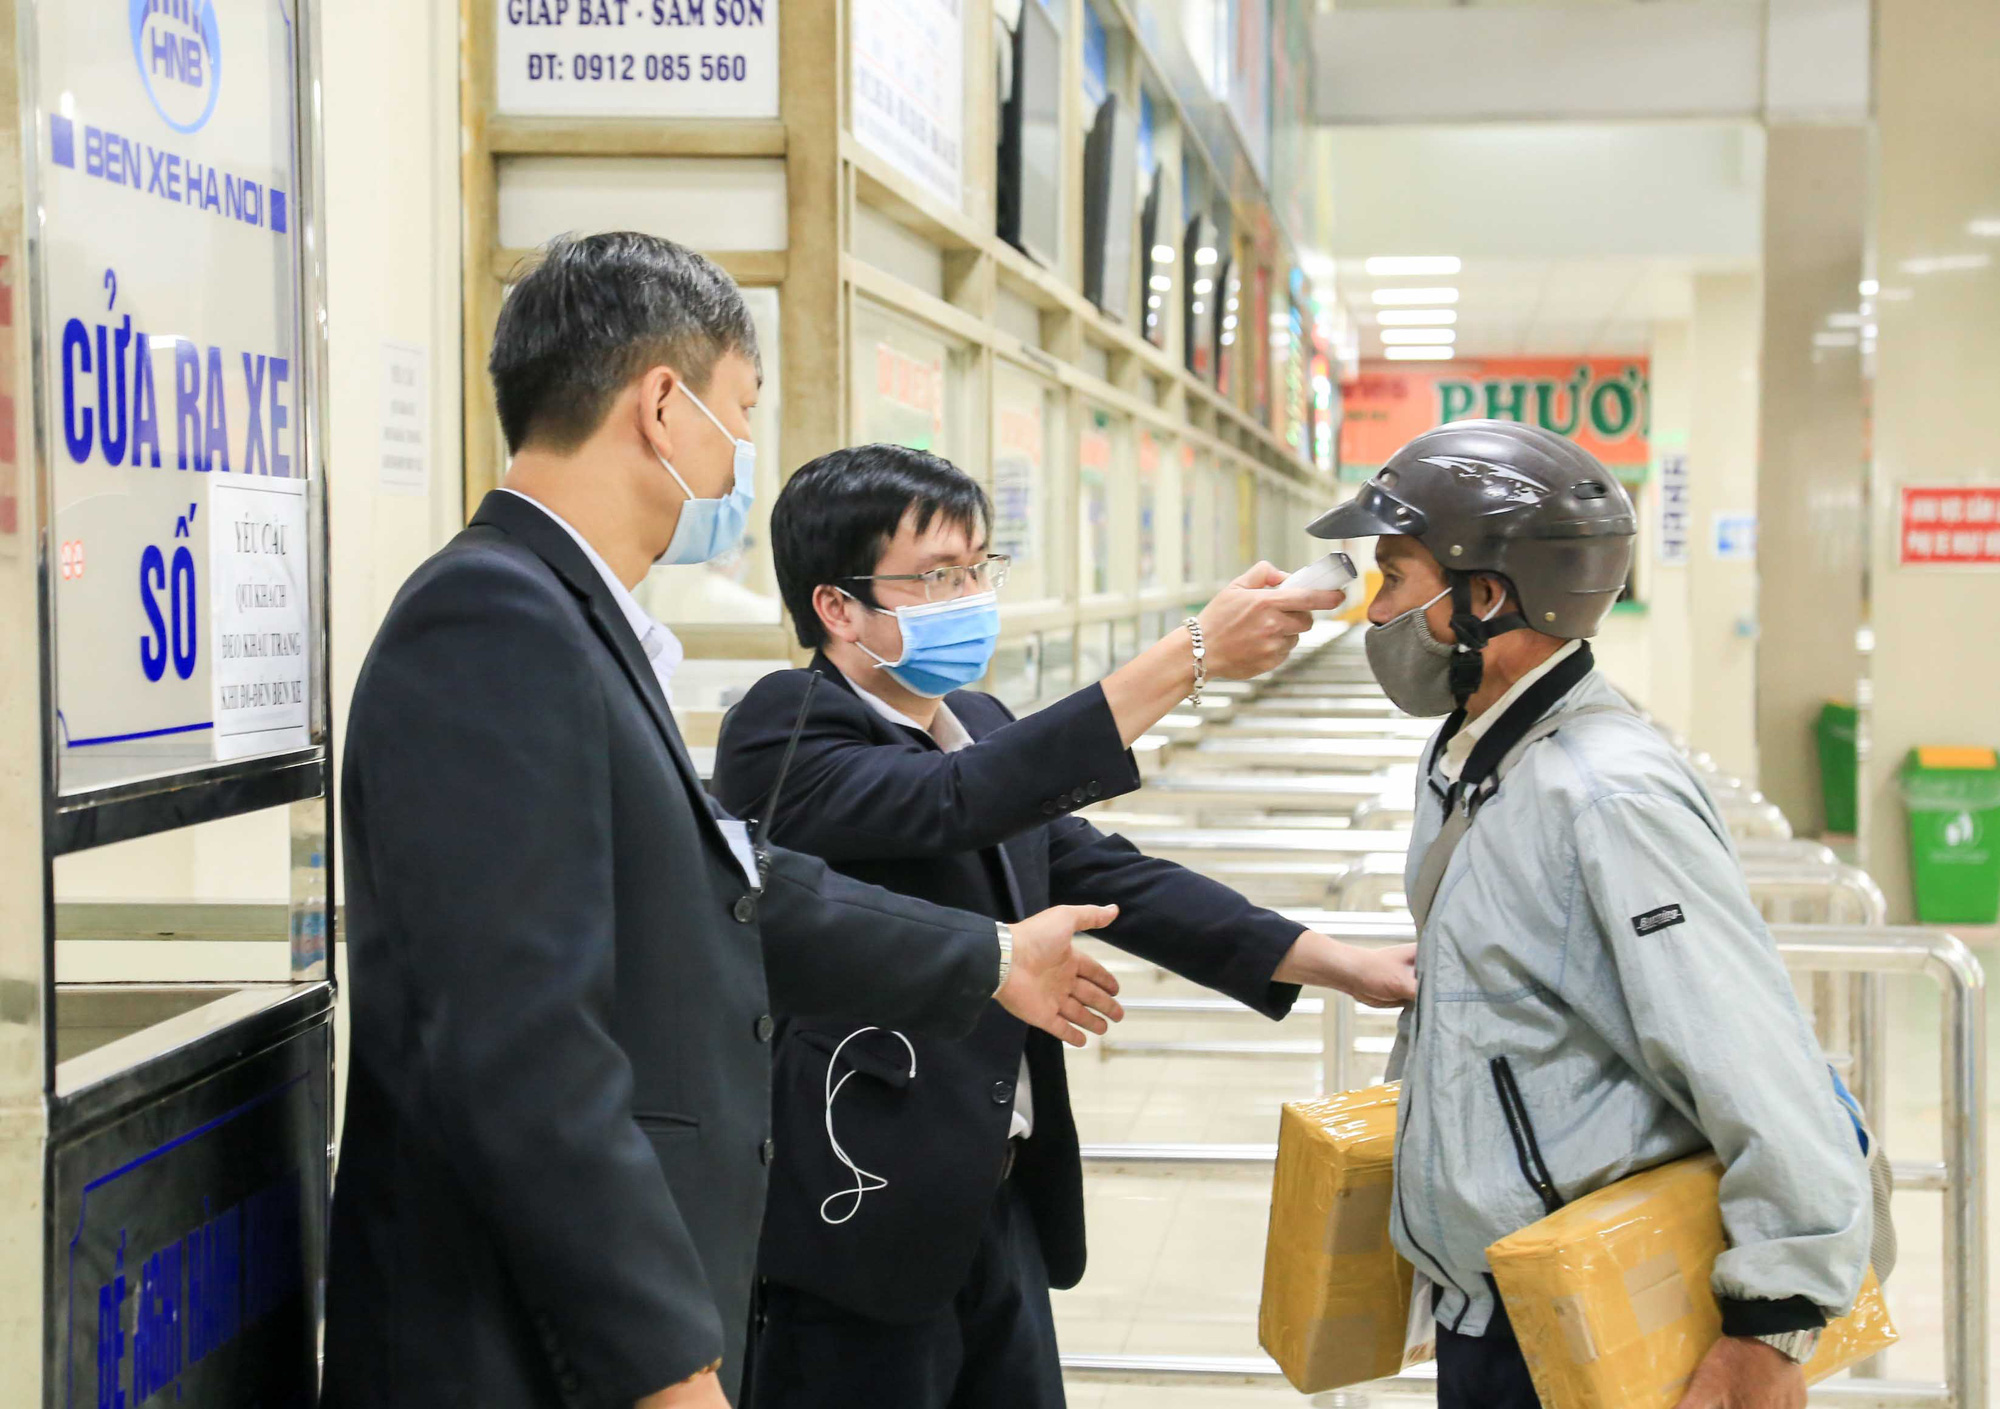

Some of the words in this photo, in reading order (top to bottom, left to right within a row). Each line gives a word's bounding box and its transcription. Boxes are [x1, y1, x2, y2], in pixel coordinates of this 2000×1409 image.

[151, 26, 203, 88] HNB
[573, 54, 635, 81] 0912
[645, 55, 691, 81] 085
[700, 55, 747, 81] 560
[147, 146, 181, 203] XE
[62, 268, 161, 468] CỬA
[175, 338, 230, 473] RA
[242, 352, 291, 478] XE
[1438, 366, 1649, 437] PHƯƠ
[140, 502, 198, 683] SỐ
